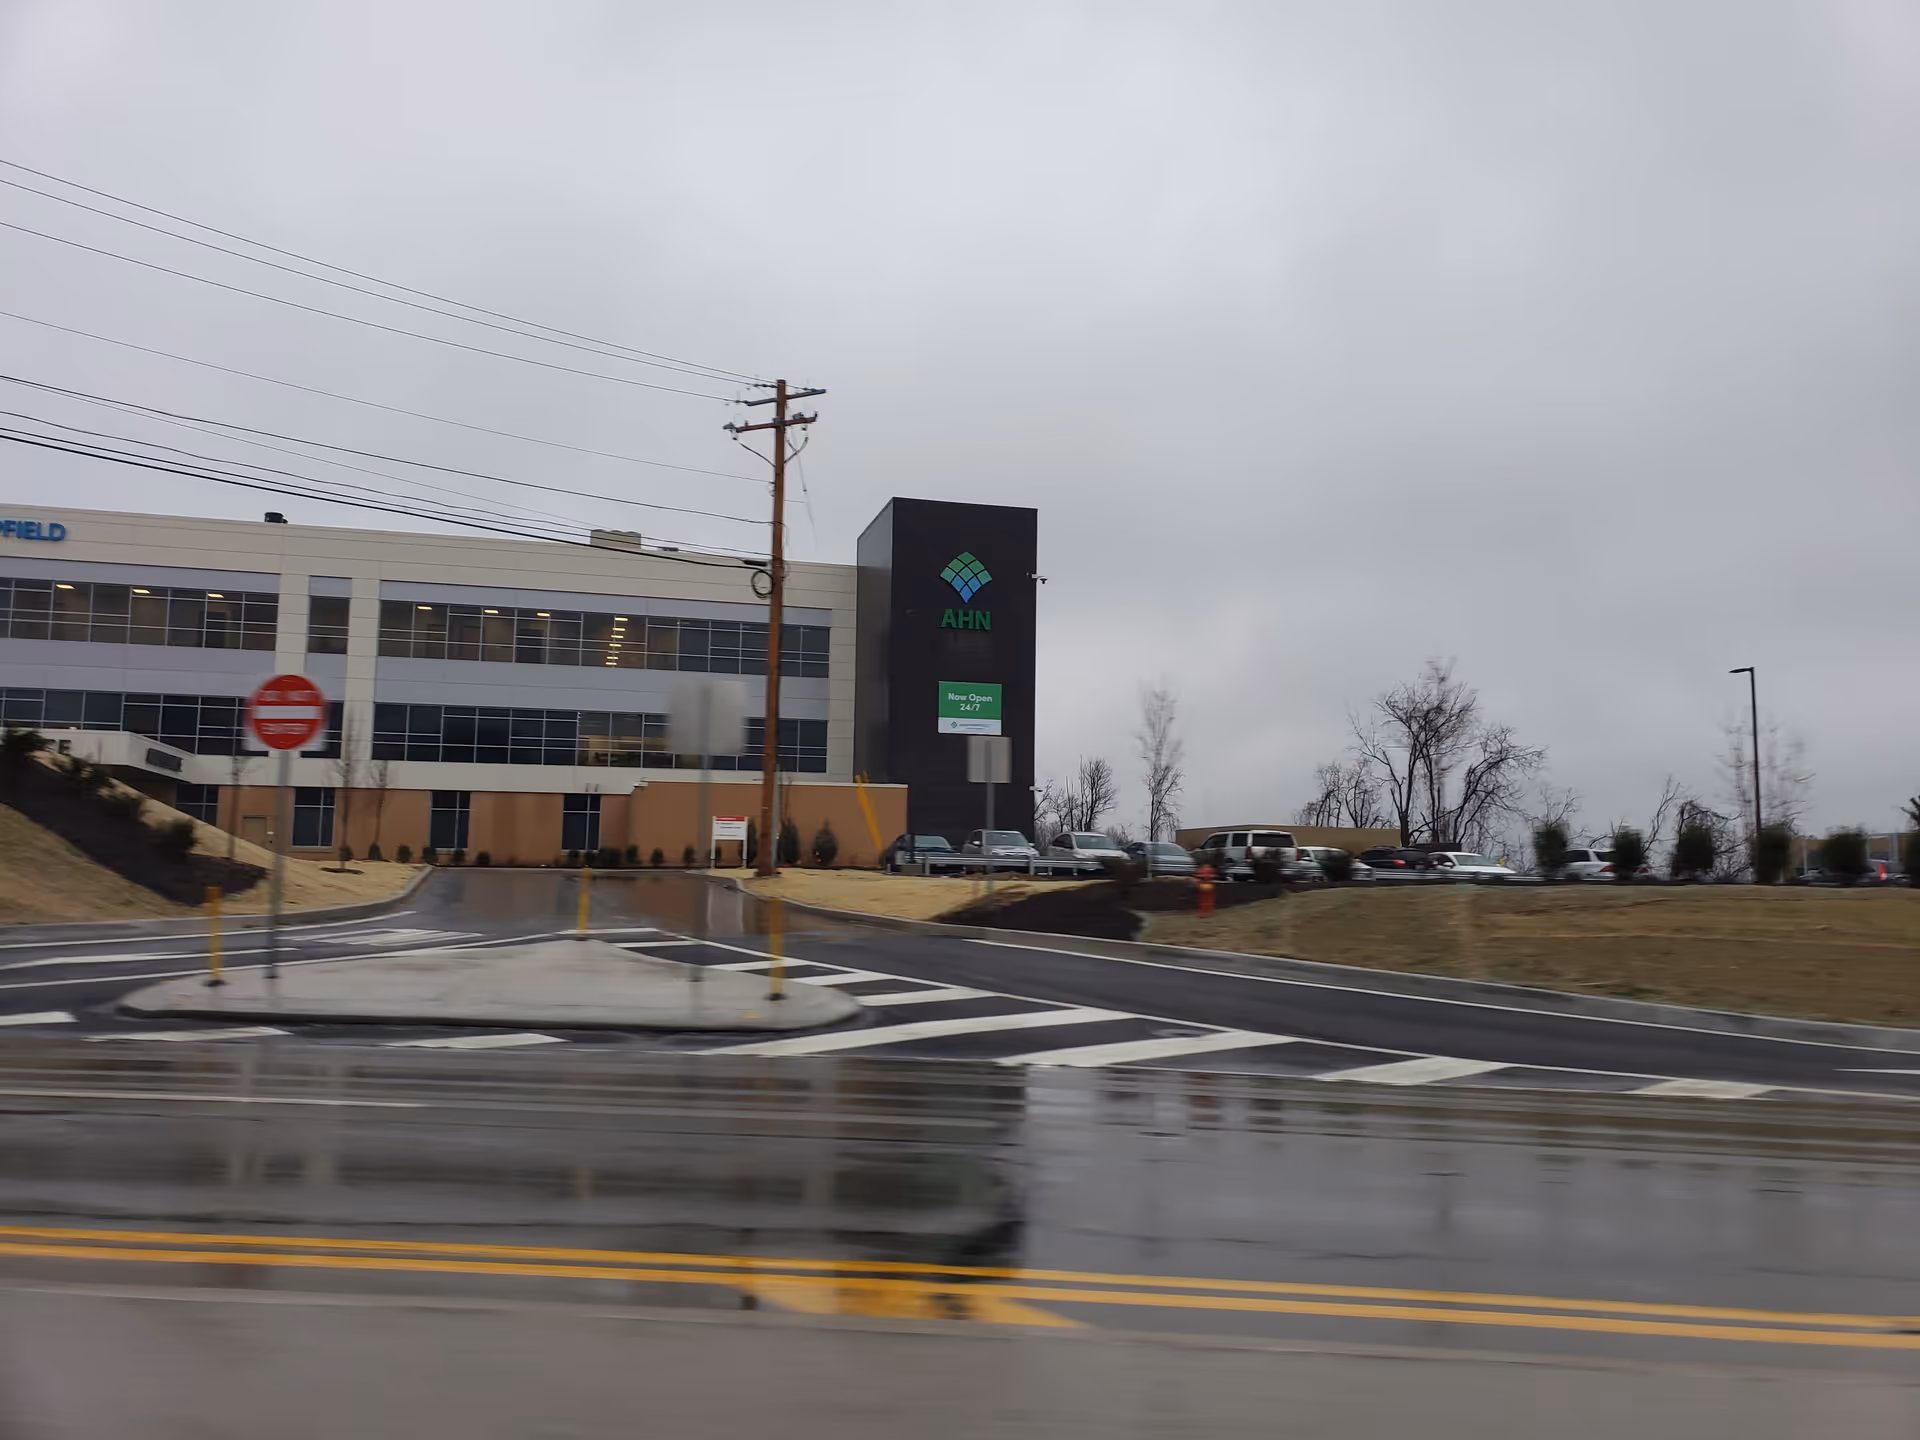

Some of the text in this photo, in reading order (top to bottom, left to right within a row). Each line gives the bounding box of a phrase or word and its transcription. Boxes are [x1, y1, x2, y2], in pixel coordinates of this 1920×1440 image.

[940, 608, 992, 631] AHN
[948, 692, 993, 703] Now Open
[960, 703, 981, 711] 24/7
